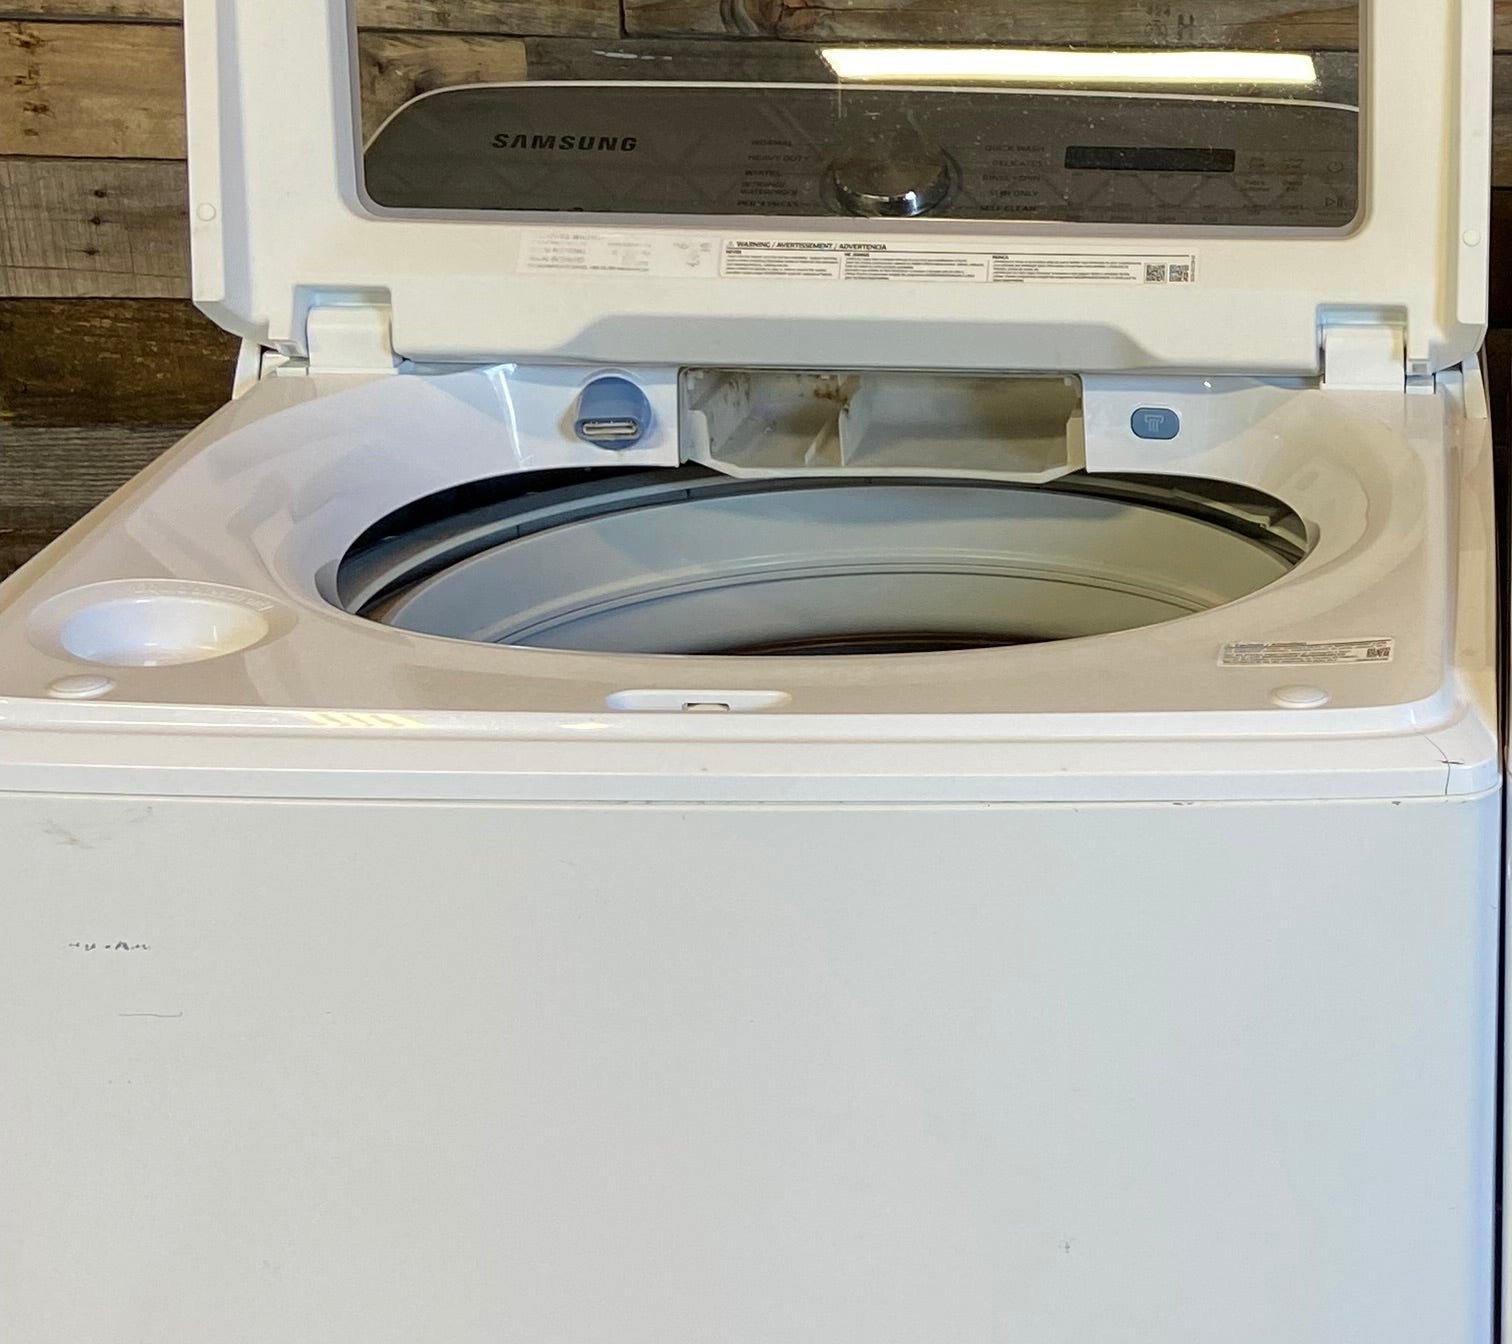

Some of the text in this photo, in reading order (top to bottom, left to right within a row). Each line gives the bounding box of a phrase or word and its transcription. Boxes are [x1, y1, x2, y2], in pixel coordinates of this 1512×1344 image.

[492, 134, 637, 151] SAMSUNG
[736, 241, 771, 249] WARNING
[776, 242, 833, 250] AVERTISSEMENT
[839, 243, 887, 251] ADVERTENCIA
